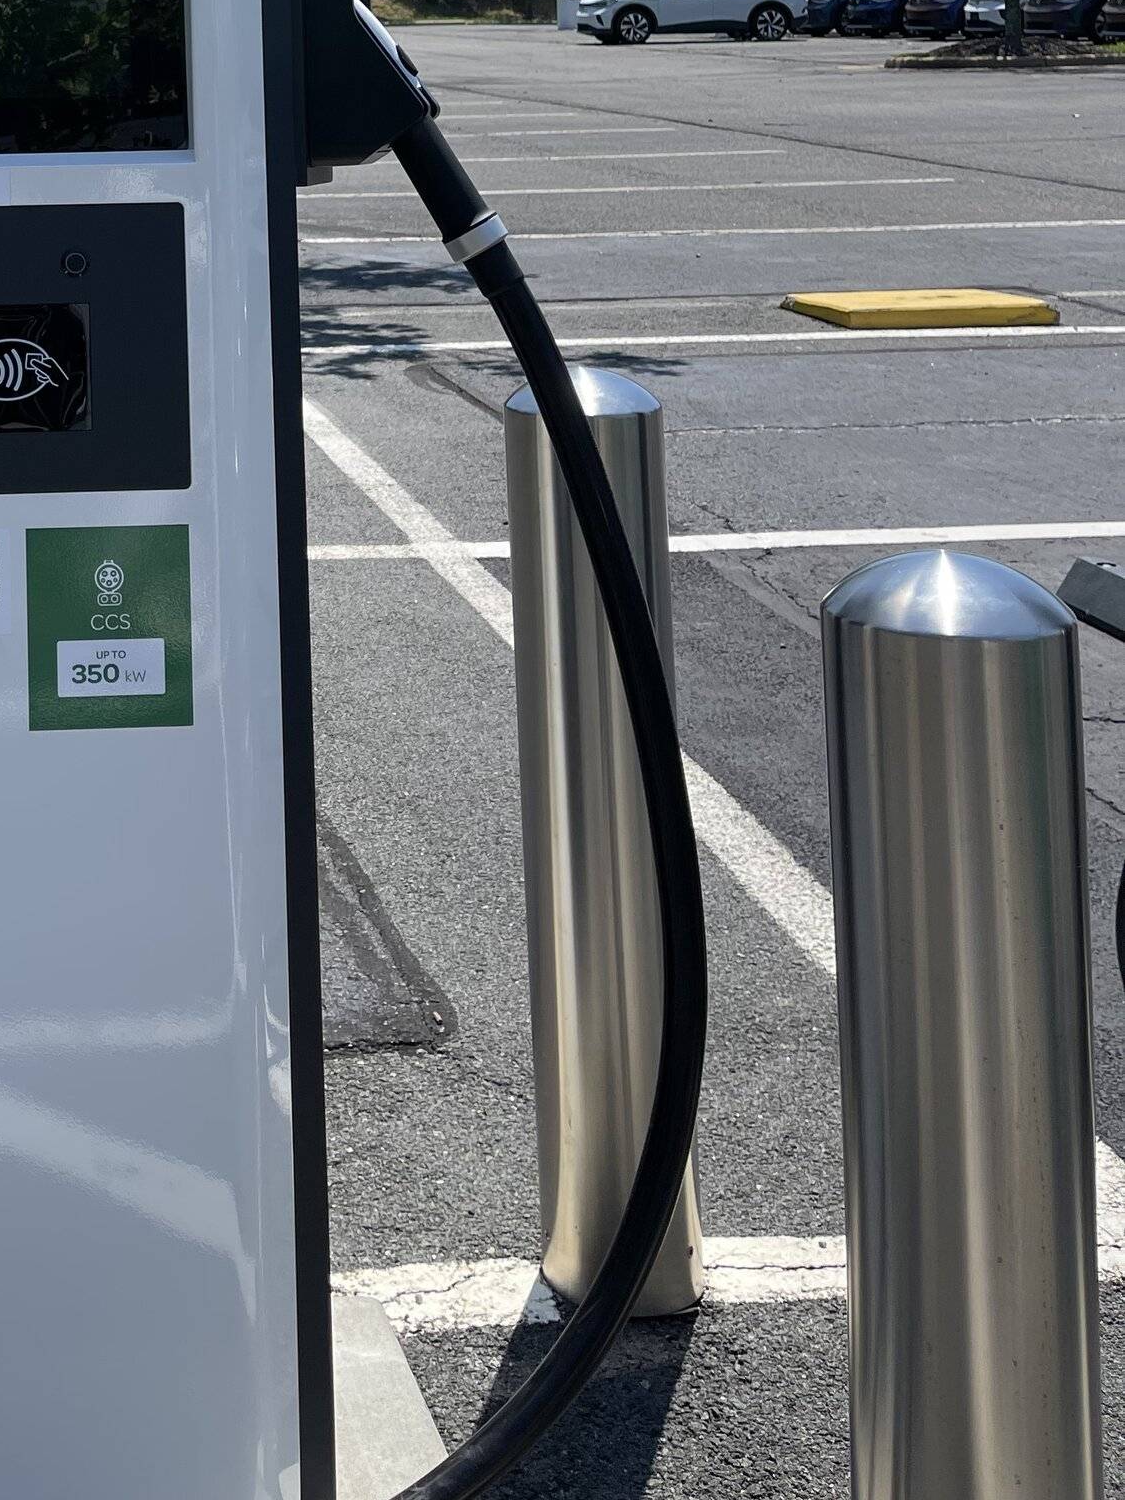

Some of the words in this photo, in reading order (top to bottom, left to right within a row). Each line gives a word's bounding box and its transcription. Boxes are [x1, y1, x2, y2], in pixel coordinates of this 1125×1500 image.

[90, 613, 131, 631] CCS
[95, 650, 110, 660] UP
[111, 650, 127, 660] TO
[71, 663, 120, 685] 350
[125, 669, 147, 683] kW
